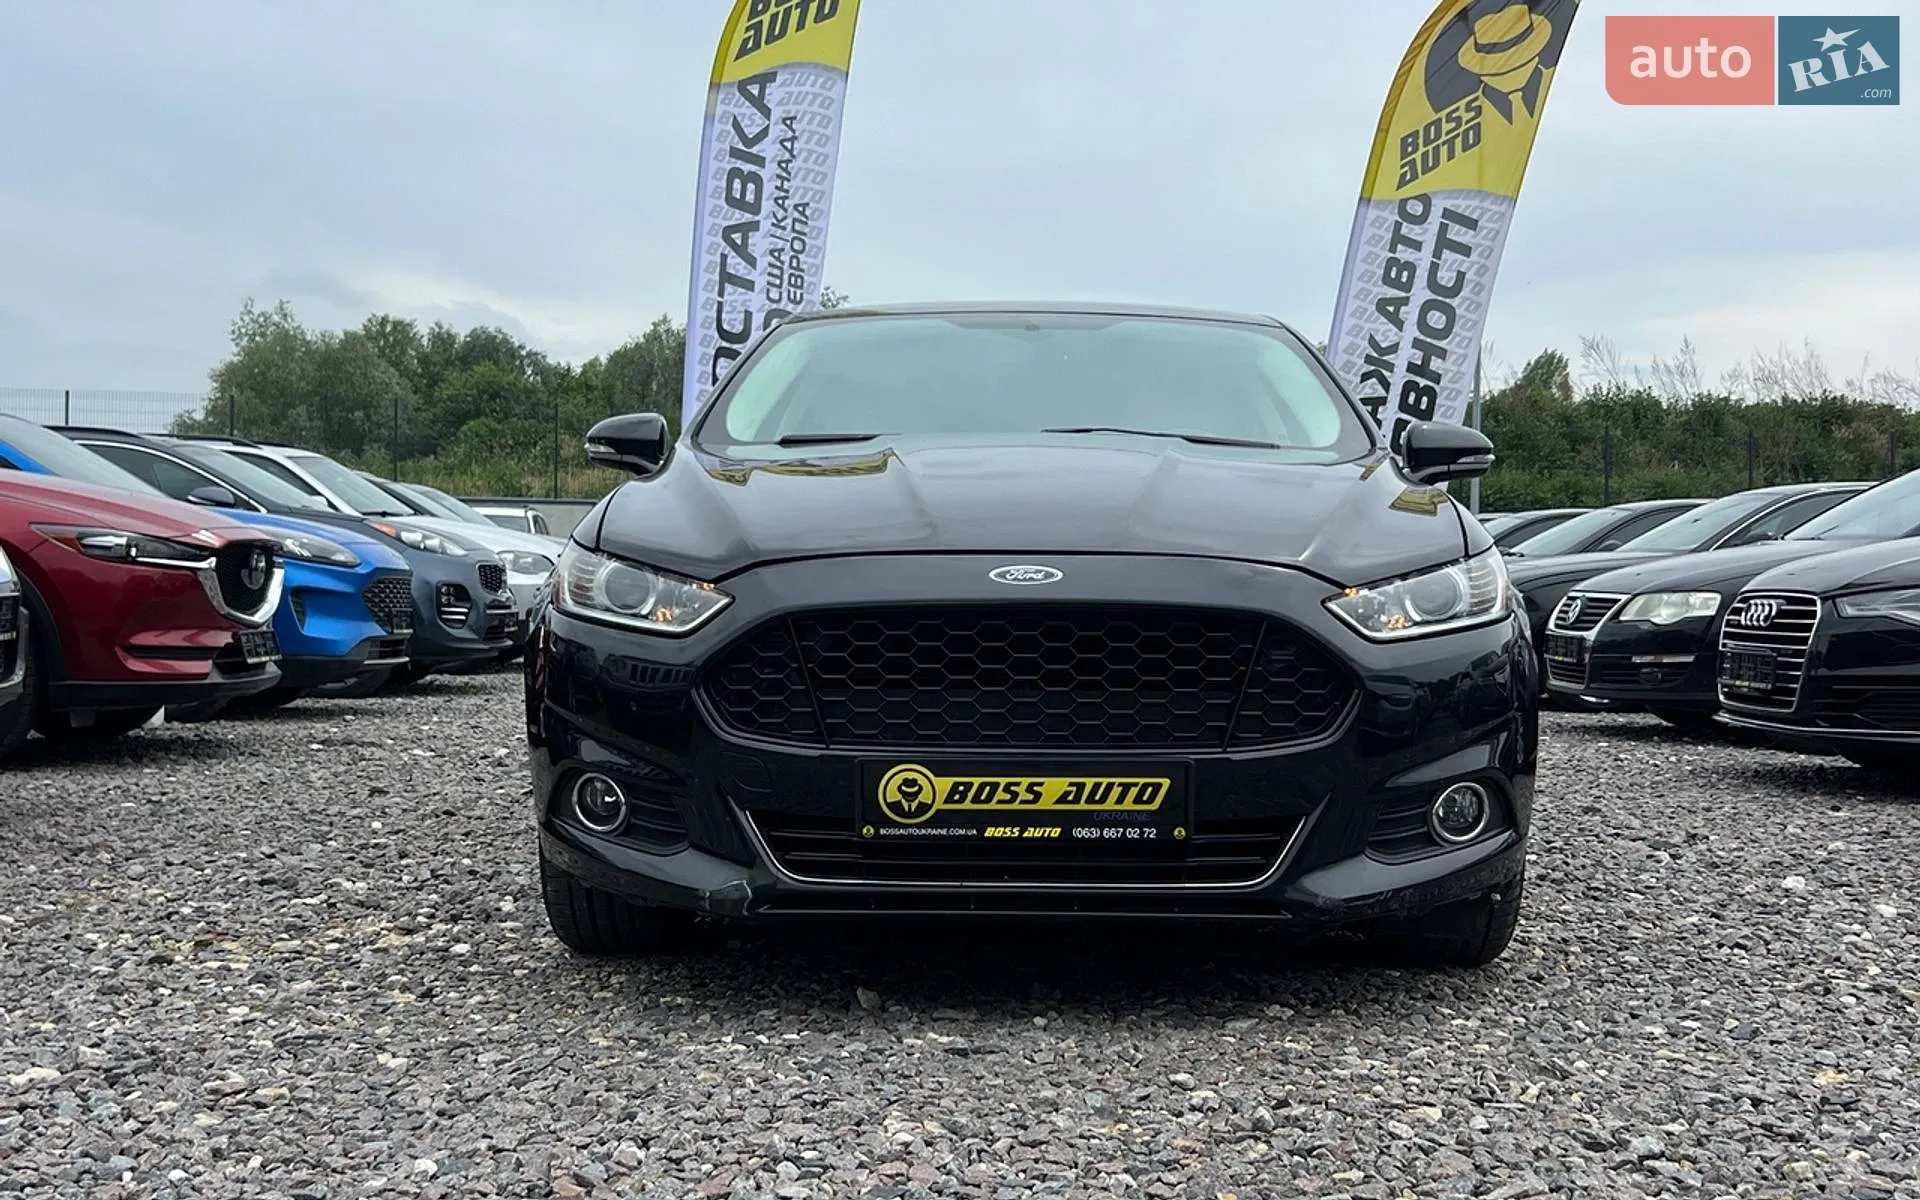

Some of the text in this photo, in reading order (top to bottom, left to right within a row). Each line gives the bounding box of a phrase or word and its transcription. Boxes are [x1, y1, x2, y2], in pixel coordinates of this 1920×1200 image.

[1396, 121, 1481, 191] AUTO
[1400, 96, 1482, 161] BOSS
[771, 115, 797, 231] КАНАДА
[766, 248, 785, 304] США
[1375, 193, 1432, 332] АВТО
[943, 781, 1164, 805] BOSS AUTO
[1094, 811, 1151, 821] UKRAINE
[983, 827, 1062, 837] BOSS AUTO
[1072, 827, 1157, 839] (063) 667 02 72
